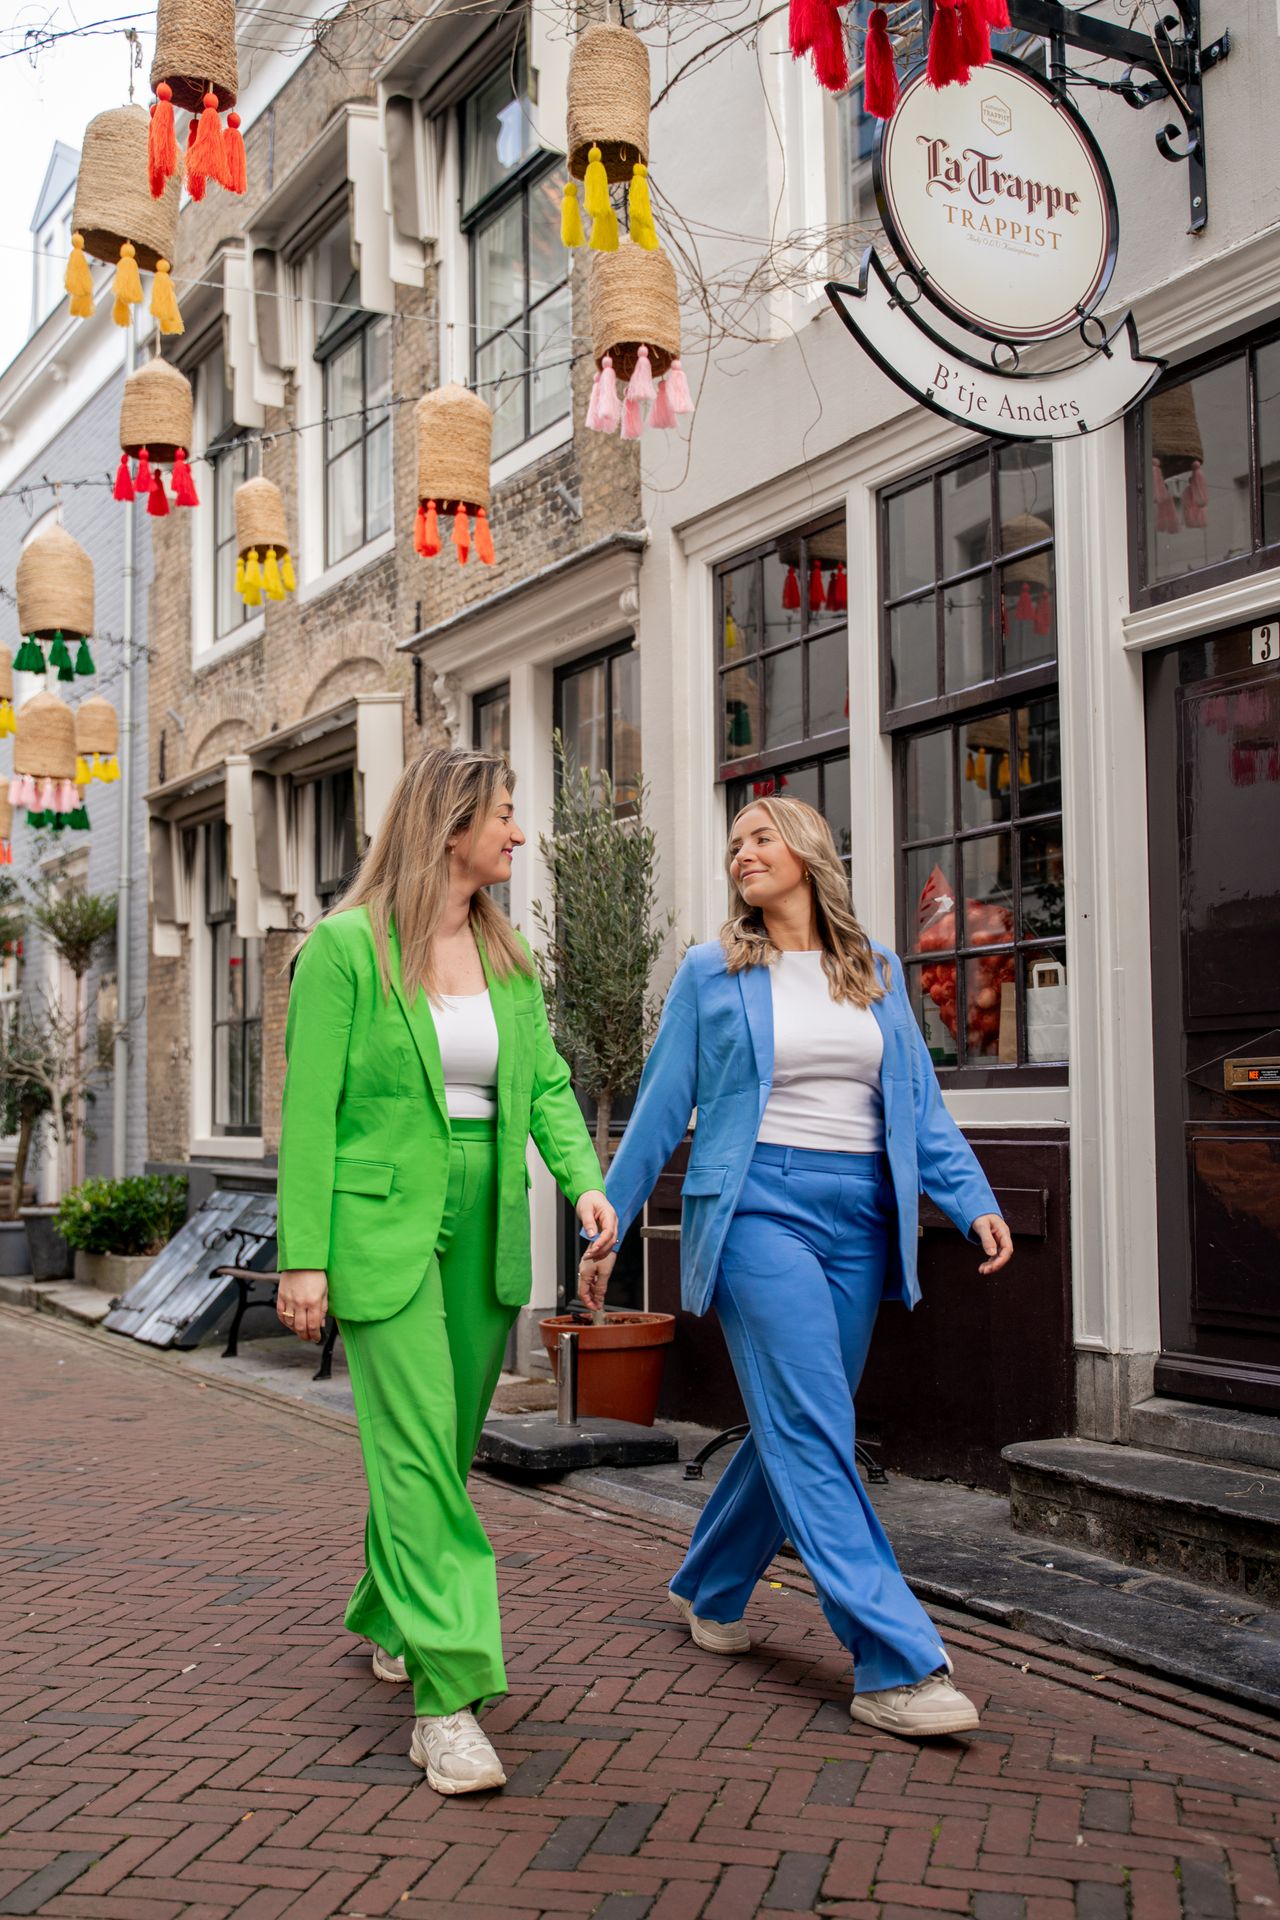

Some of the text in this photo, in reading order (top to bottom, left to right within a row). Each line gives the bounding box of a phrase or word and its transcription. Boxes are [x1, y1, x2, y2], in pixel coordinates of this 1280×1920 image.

[916, 135, 1081, 220] La Trappe
[942, 203, 1062, 250] TRAPPIST
[997, 394, 1080, 422] Anders
[1260, 626, 1271, 660] 3
